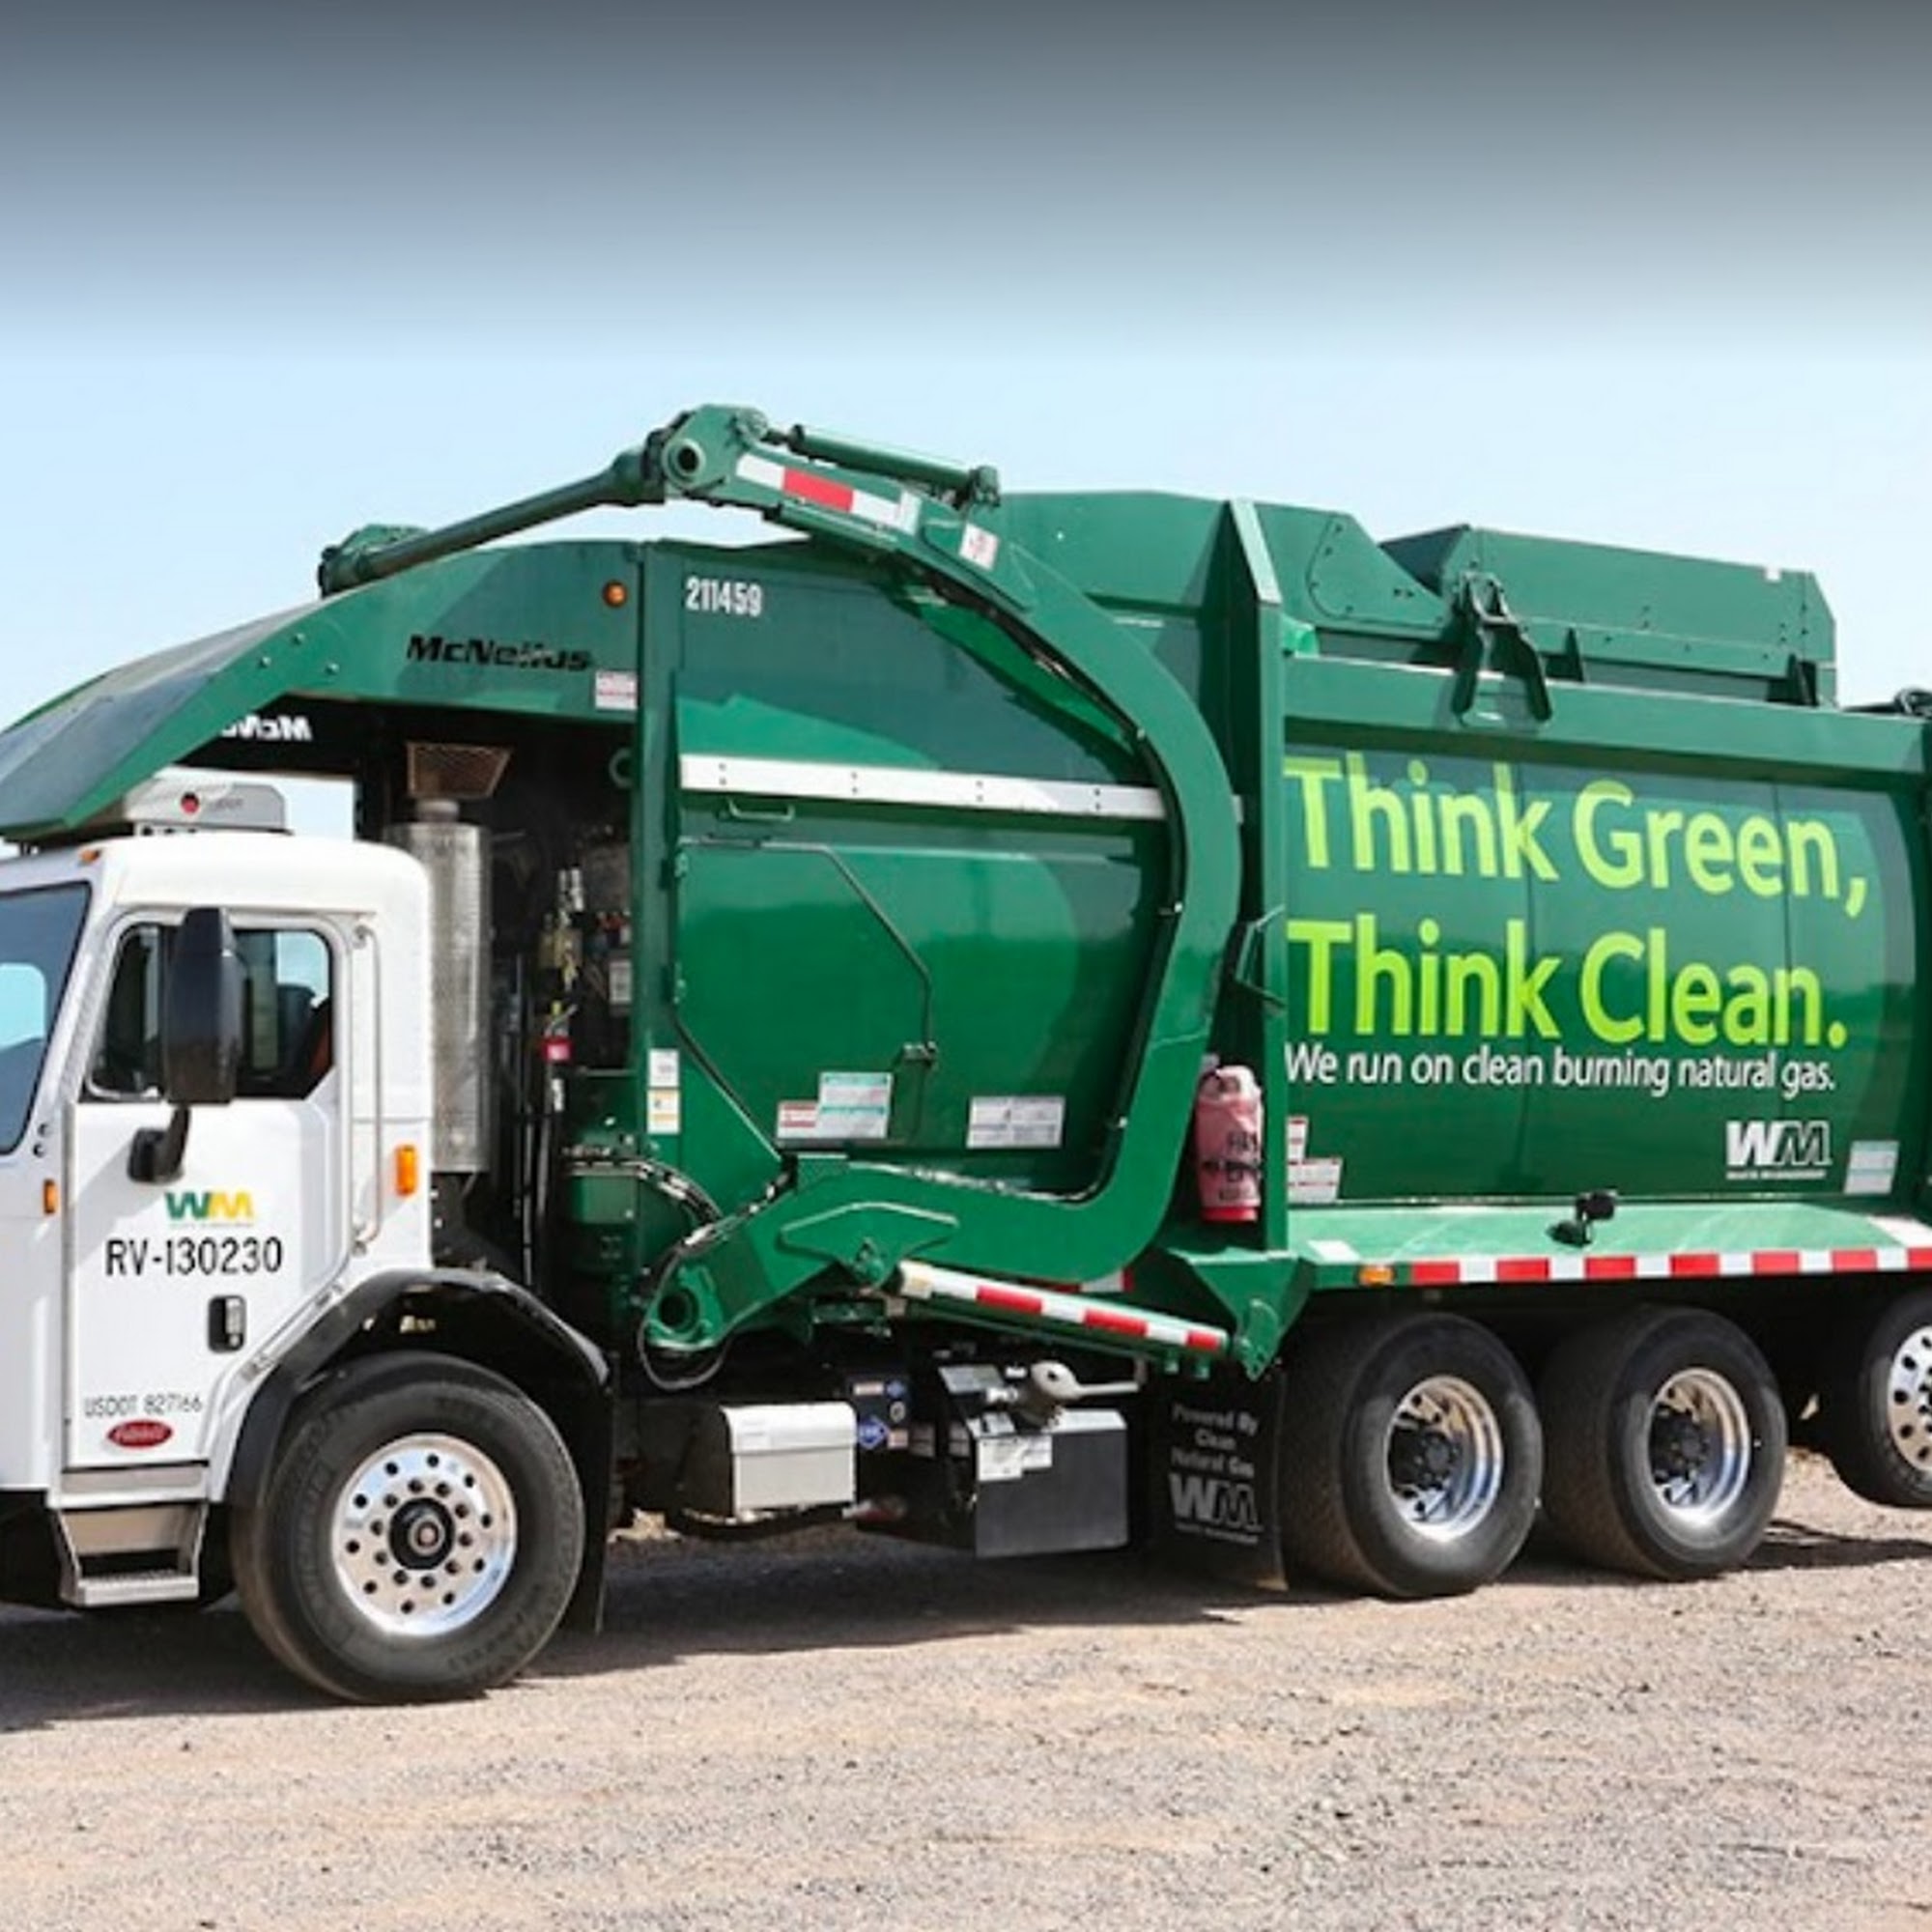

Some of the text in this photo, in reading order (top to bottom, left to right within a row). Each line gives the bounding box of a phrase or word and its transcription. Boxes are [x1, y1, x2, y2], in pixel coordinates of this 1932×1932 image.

[685, 576, 763, 616] 211459
[1284, 751, 1867, 919] Think Green,
[1287, 913, 1848, 1048] Think Clean.
[1285, 1041, 1836, 1101] We run on clean burning natural gas.
[1726, 1120, 1833, 1167] WM
[165, 1191, 254, 1219] WM
[105, 1236, 283, 1276] RV-130230
